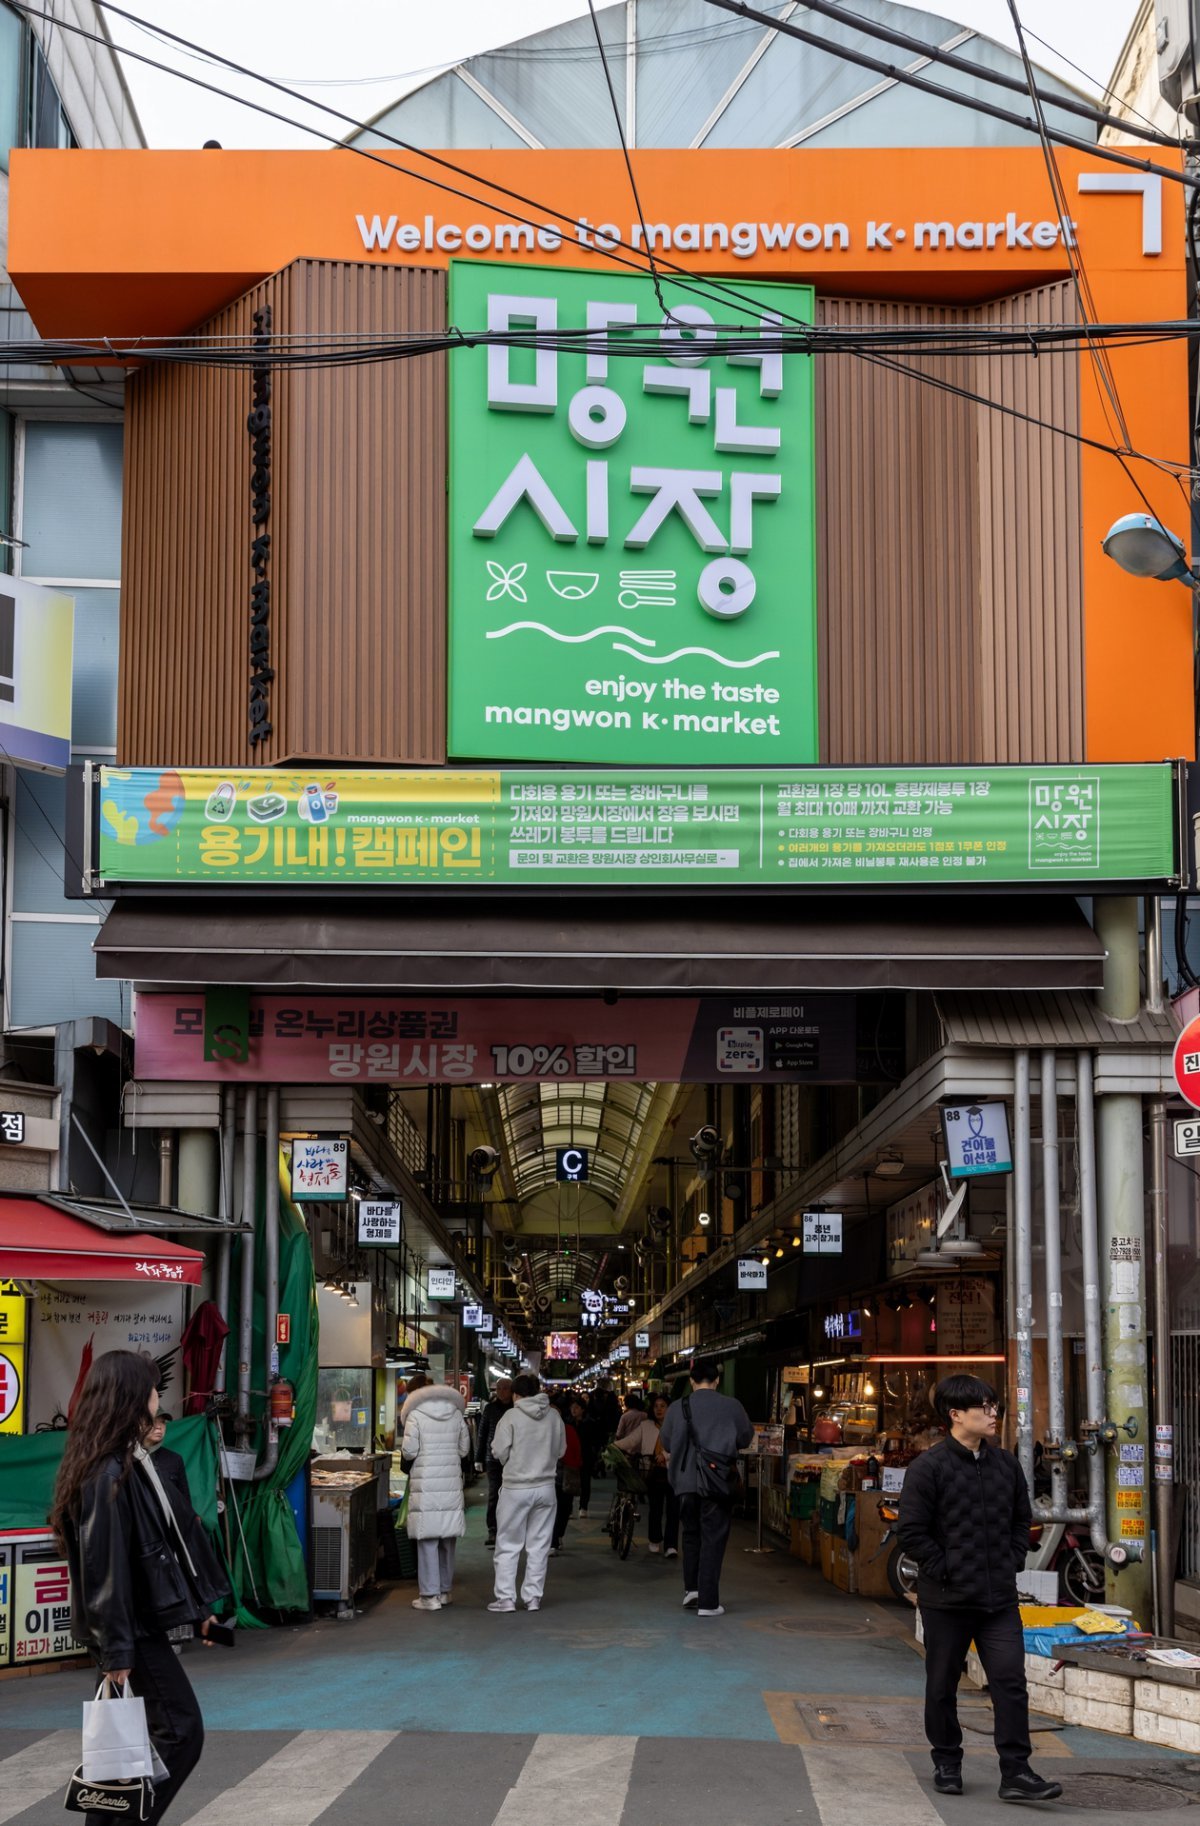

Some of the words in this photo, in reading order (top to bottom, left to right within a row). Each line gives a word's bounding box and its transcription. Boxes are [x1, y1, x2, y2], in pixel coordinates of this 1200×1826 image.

[355, 214, 563, 251] Welcome
[574, 216, 621, 252] to
[631, 220, 849, 258] mangwon
[487, 293, 783, 456] 망원
[472, 452, 782, 620] 시장
[585, 674, 657, 703] enjoy
[662, 677, 706, 701] the
[711, 681, 780, 705] taste
[485, 705, 632, 731] mangwon
[509, 784, 557, 801] 다회용
[560, 784, 591, 801] 용기
[594, 784, 627, 801] 또는
[630, 784, 708, 801] 장바구니를
[776, 783, 820, 798] 교환권
[822, 783, 843, 798] 1장
[847, 783, 862, 797] 당
[865, 783, 892, 798] 10L
[895, 782, 965, 798] 종량제봉투
[968, 781, 991, 797] 1장
[1035, 784, 1092, 812] 망원
[509, 805, 558, 823] 가져와
[560, 805, 654, 823] 망원시장에서
[657, 805, 689, 823] 장을
[692, 804, 740, 822] 보시면
[777, 802, 791, 816] 월
[794, 801, 823, 816] 최대
[826, 801, 857, 816] 10매
[860, 800, 889, 816] 까지
[892, 800, 921, 816] 교환
[924, 800, 953, 815] 가능
[347, 815, 413, 825] mangwon
[1034, 814, 1092, 841] 시장
[509, 826, 557, 844] 쓰레기
[560, 826, 607, 844] 봉투를
[610, 826, 674, 844] 드립니다
[868, 827, 909, 838] 장바구니
[912, 827, 932, 838] 인정
[352, 826, 482, 868] 캠페인
[517, 853, 539, 865] 문의
[556, 853, 588, 865] 교환은
[592, 853, 637, 865] 망원시장
[943, 856, 962, 867] 인정
[174, 1008, 264, 1037] 모일
[274, 1008, 459, 1039] 온누리상품권
[769, 1027, 788, 1035] APP
[328, 1043, 479, 1078] 망원시장
[491, 1045, 567, 1076] 10%
[574, 1045, 638, 1076] 할인
[946, 1111, 960, 1122] 88
[1, 1113, 24, 1142] 점
[333, 1143, 346, 1152] 89
[961, 1138, 995, 1153] 건어물
[562, 1150, 582, 1173] C
[963, 1151, 997, 1165] 이선생
[367, 1206, 393, 1216] 바다를
[804, 1215, 813, 1223] 86
[362, 1217, 396, 1228] 사랑하는
[366, 1228, 392, 1238] 형제들
[34, 1566, 70, 1604] 금
[16, 1638, 50, 1657] 최고가
[76, 1788, 128, 1806] California
